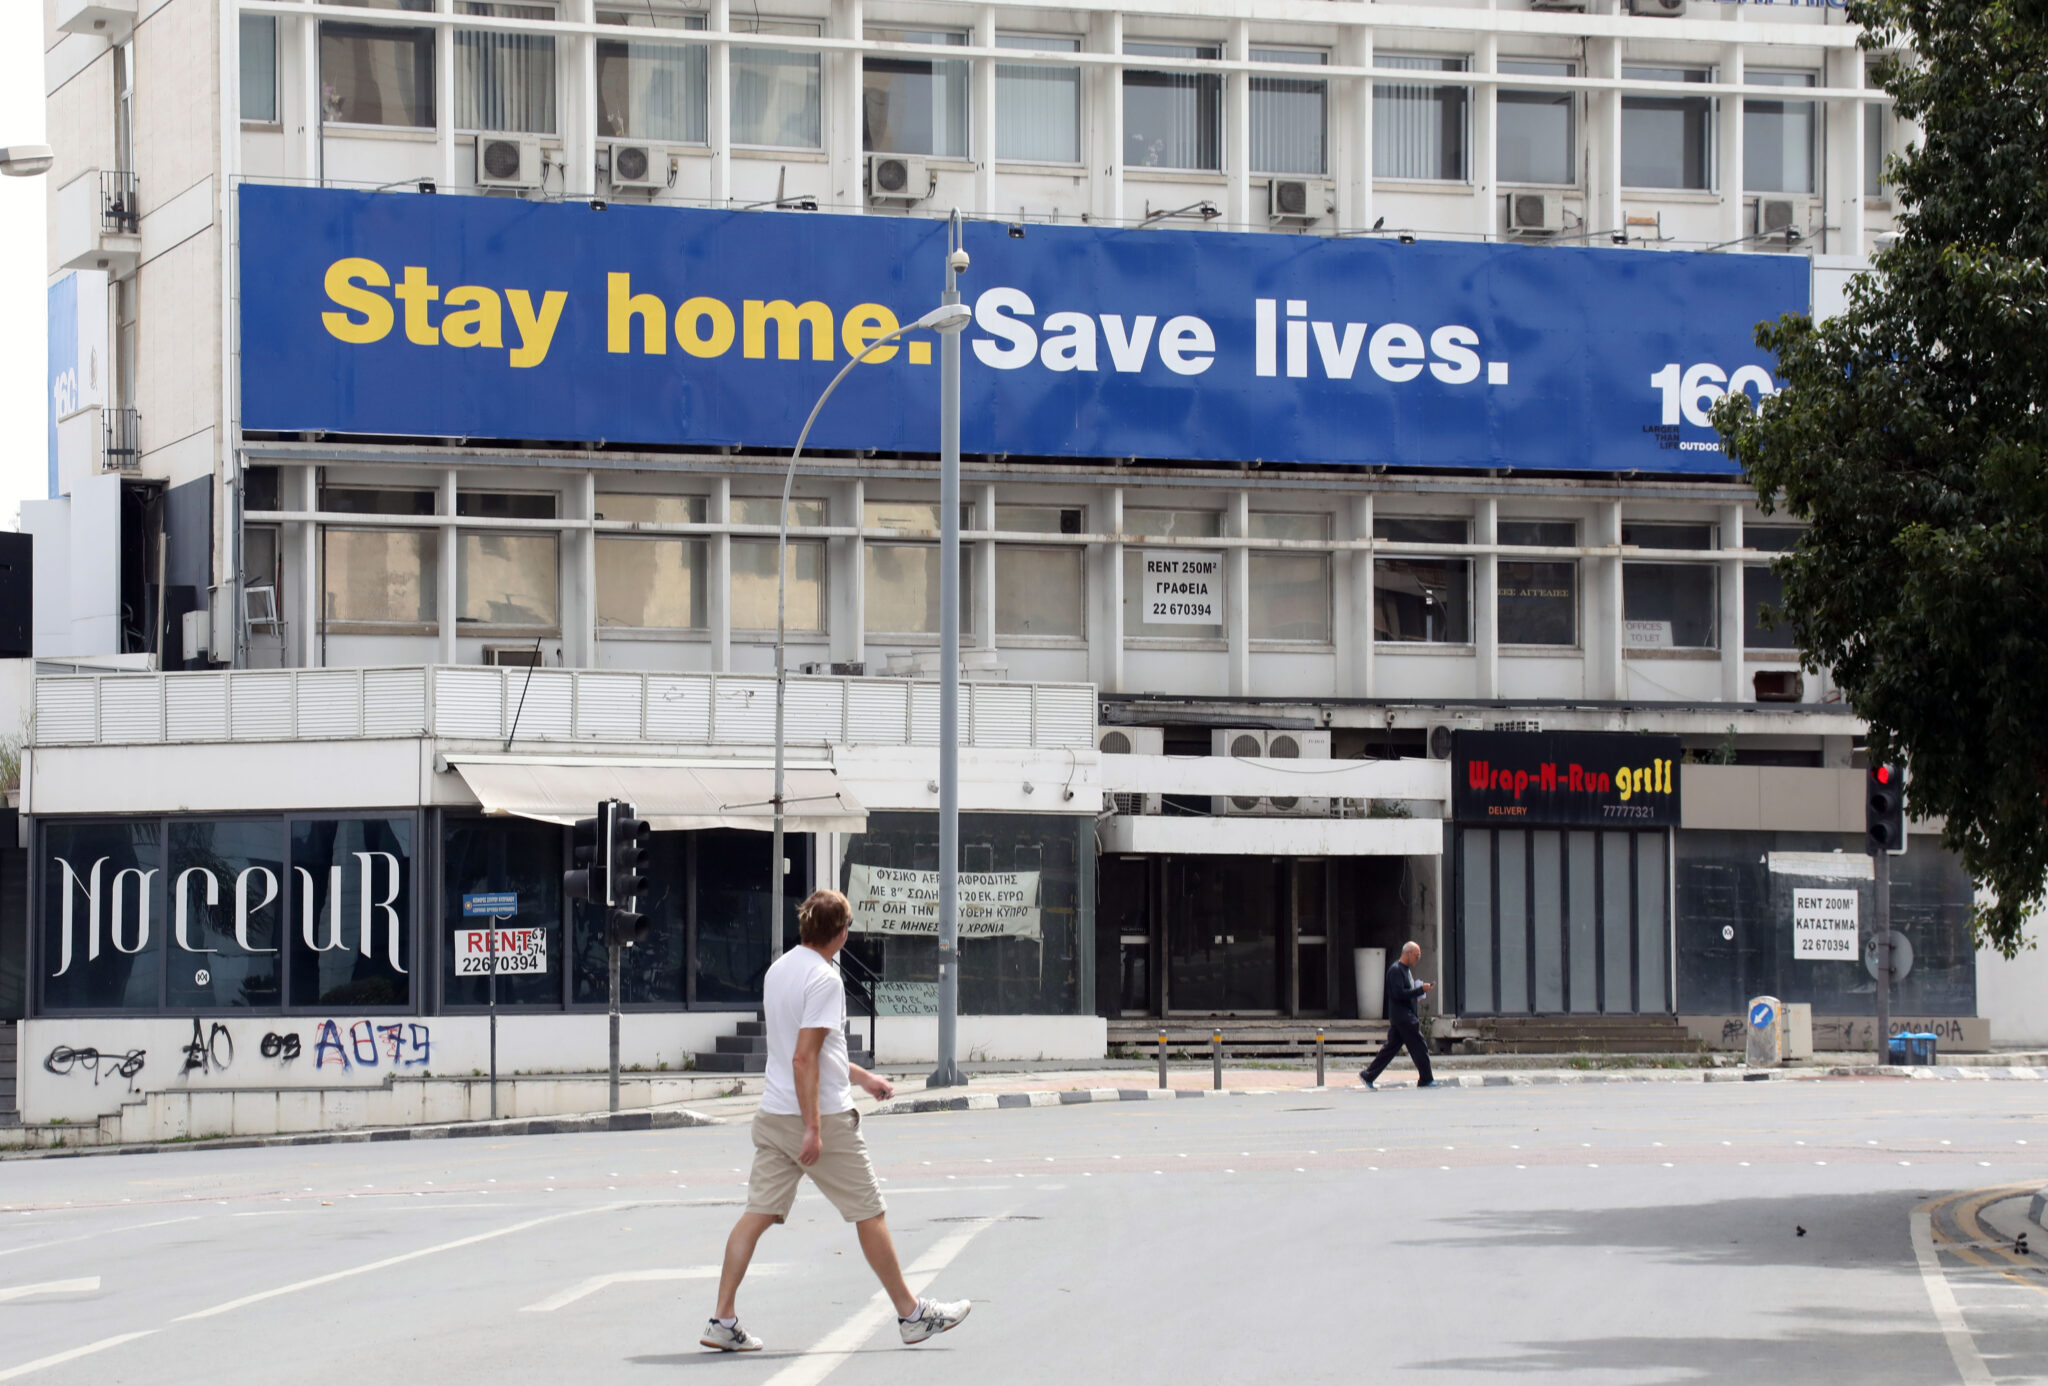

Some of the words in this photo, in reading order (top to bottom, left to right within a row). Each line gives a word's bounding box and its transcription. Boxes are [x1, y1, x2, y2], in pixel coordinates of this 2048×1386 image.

[321, 257, 568, 368] Stay
[607, 271, 932, 365] home.
[972, 287, 1216, 376] Save
[1255, 298, 1509, 385] lives.
[1643, 424, 1680, 433] LARGER
[1655, 433, 1680, 441] THAN
[1680, 442, 1726, 452] OUTDOO
[1147, 561, 1179, 573] RENT
[1156, 582, 1208, 595] ΓΡΑΦΕΙΑ
[1153, 603, 1167, 615] 22
[1169, 603, 1212, 616] 670394
[1626, 622, 1662, 631] OFFICES
[1631, 634, 1643, 642] TO
[1645, 634, 1660, 642] LET
[1469, 760, 1610, 799] Wrap-N-Run
[1488, 806, 1527, 816] DELIVERY
[1603, 805, 1655, 818] 77777321
[877, 869, 916, 882] ΦΥΣΙΚΟ
[870, 886, 885, 896] ΜΕ
[997, 891, 1024, 902] ΕΥΡΩ
[858, 900, 876, 912] ΓΙΑ
[882, 903, 906, 914] ΟΛΗ
[911, 905, 934, 915] ΤΗΝ
[1798, 897, 1823, 909] RENT
[881, 919, 896, 929] ΣΕ
[967, 923, 1004, 933] ΧΡΟΝΙΑ
[1796, 918, 1855, 931] ΚΑΤΑΣΤΗΜΑ
[467, 931, 531, 953] RENT
[1802, 939, 1813, 951] 22
[1815, 939, 1849, 951] 670394
